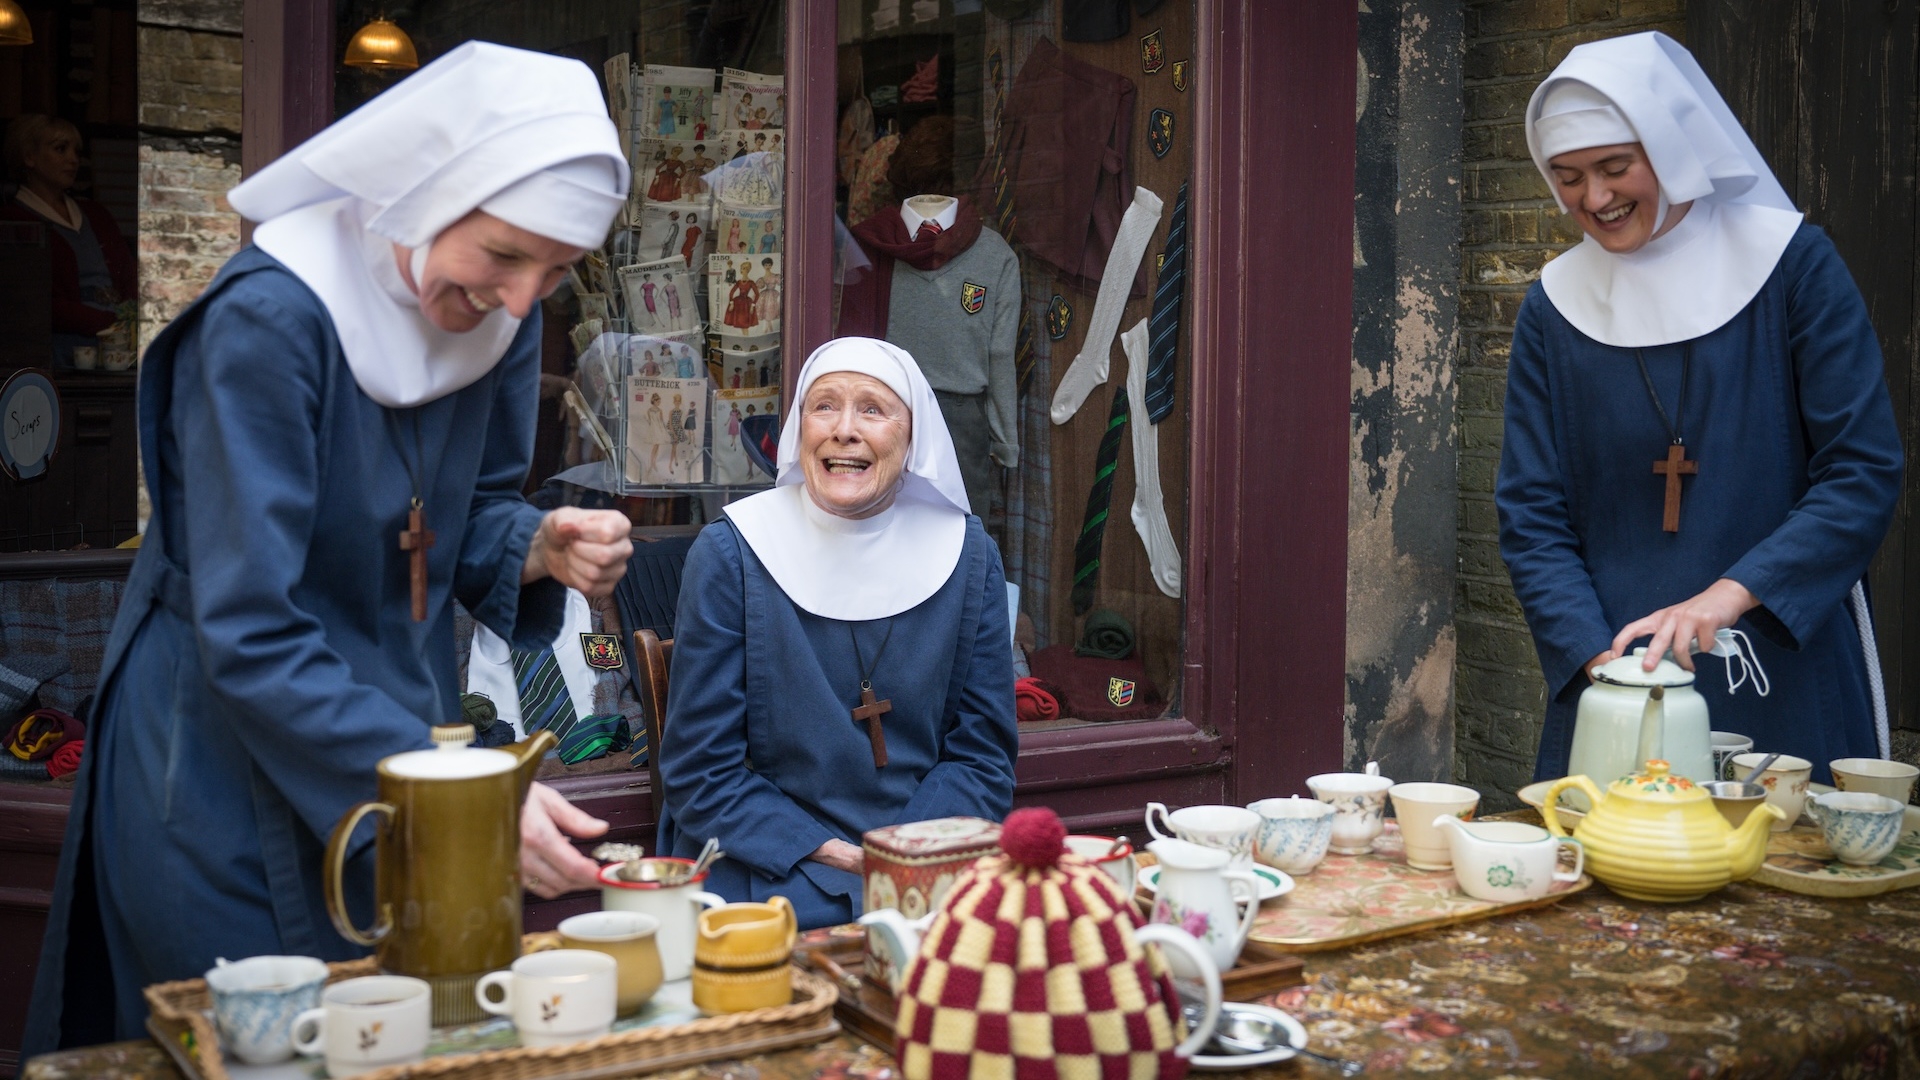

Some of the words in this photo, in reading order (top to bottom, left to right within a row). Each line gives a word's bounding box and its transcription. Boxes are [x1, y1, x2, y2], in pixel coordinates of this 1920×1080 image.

[726, 68, 746, 77] 3150
[678, 87, 692, 98] Jiffy
[737, 210, 775, 220] Simplicity
[625, 263, 670, 275] MAUDELLA
[634, 379, 681, 390] BUTTERICK
[11, 410, 41, 440] Scraps
